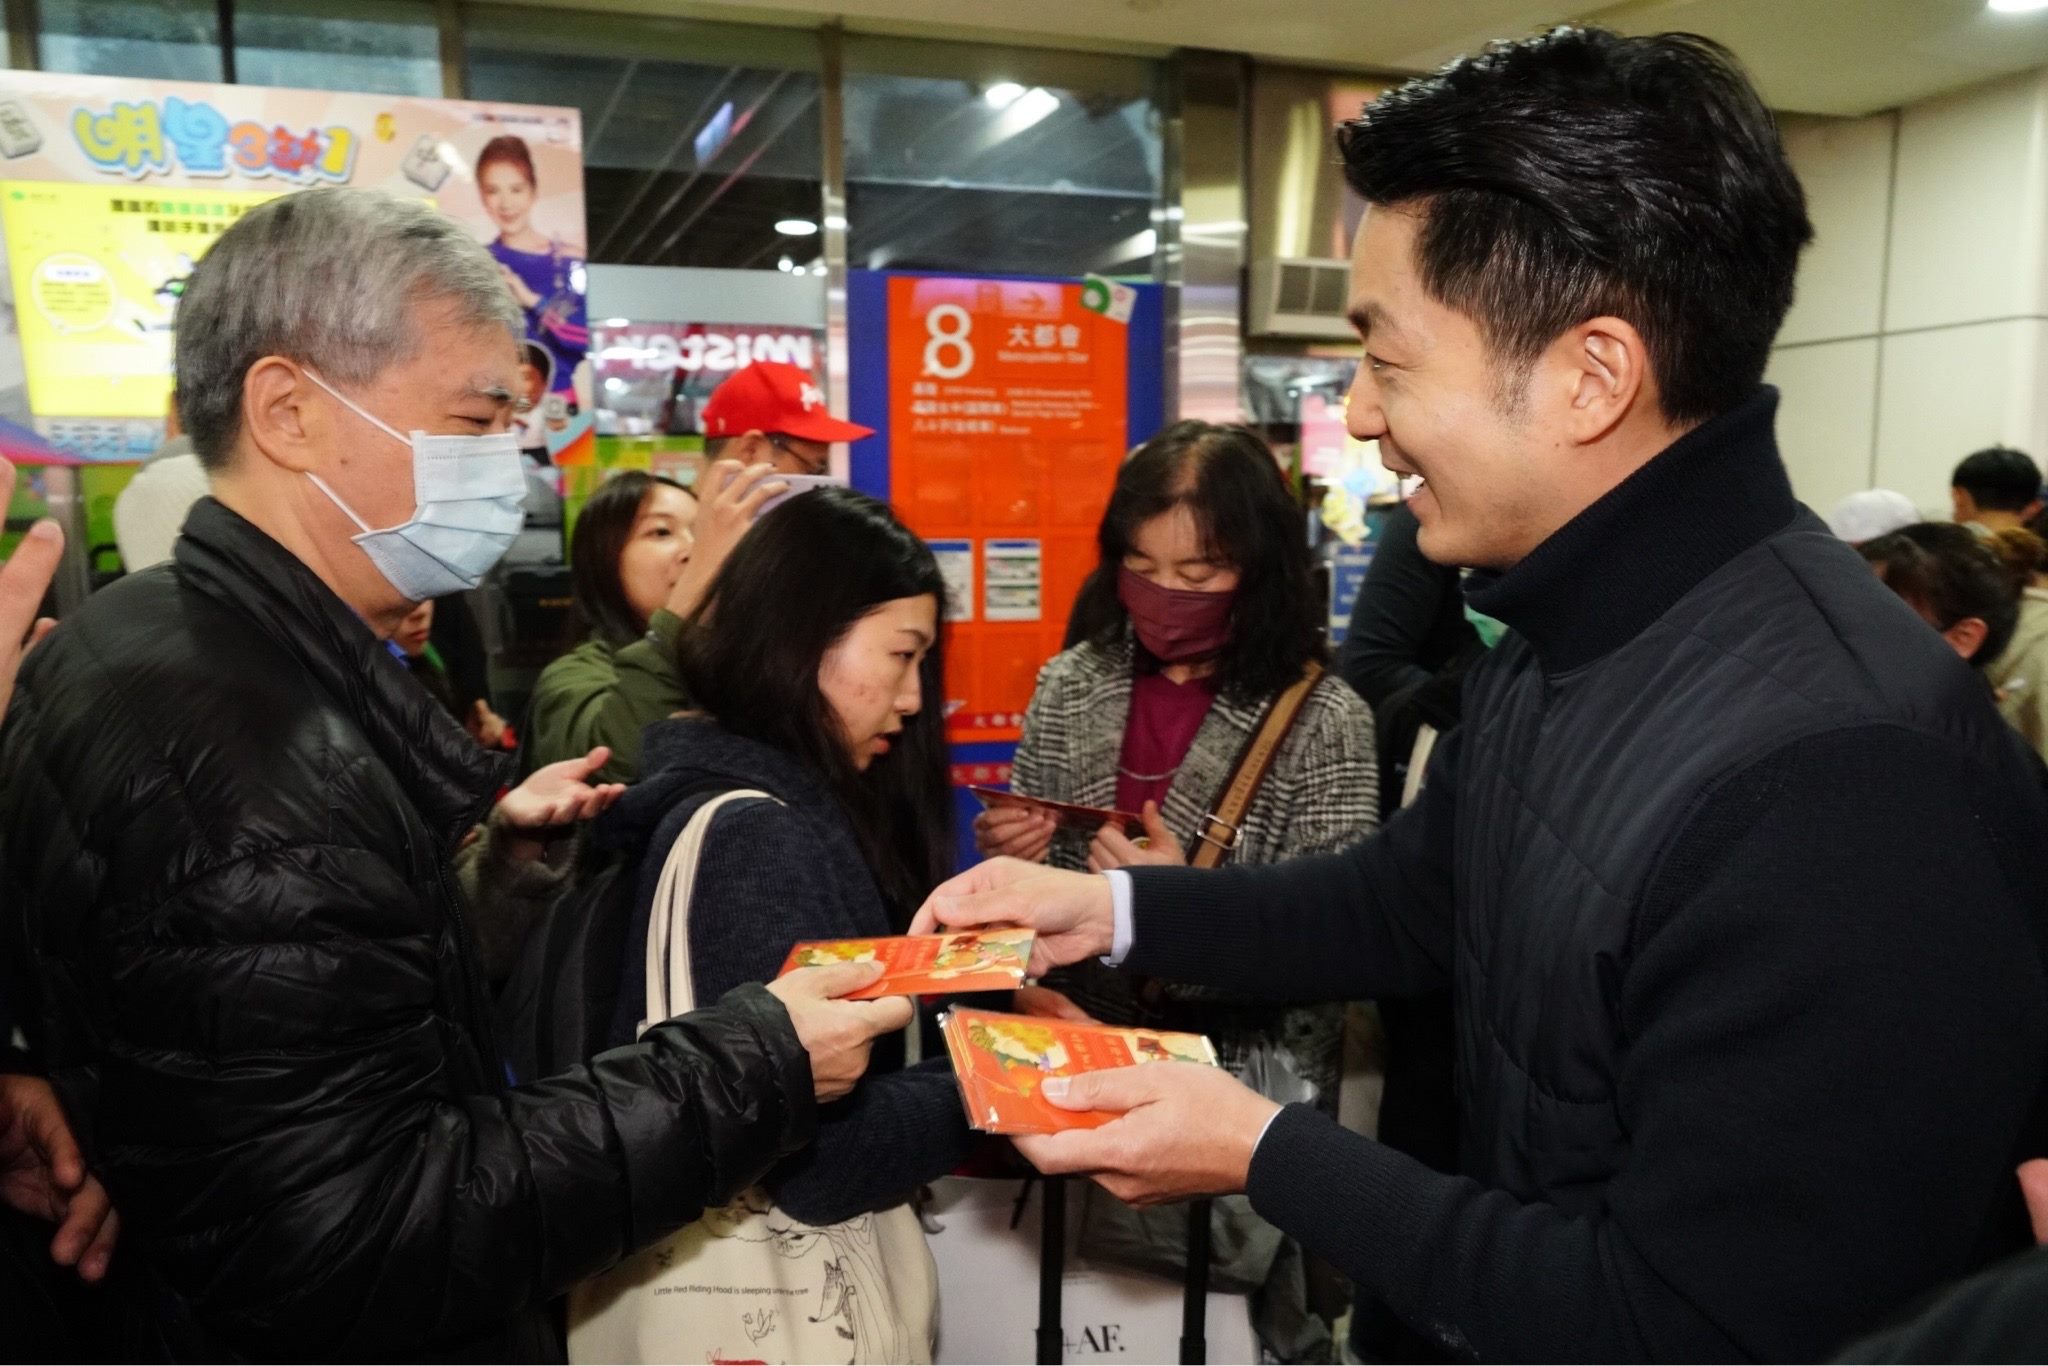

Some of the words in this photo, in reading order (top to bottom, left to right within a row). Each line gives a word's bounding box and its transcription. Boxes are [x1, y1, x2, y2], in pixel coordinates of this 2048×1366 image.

[924, 304, 974, 379] 8
[1007, 323, 1081, 348] 大都會
[654, 1288, 673, 1297] Little
[674, 1286, 688, 1294] Red
[689, 1285, 712, 1296] Riding
[713, 1286, 733, 1295] Hood
[742, 1287, 772, 1297] sleeping
